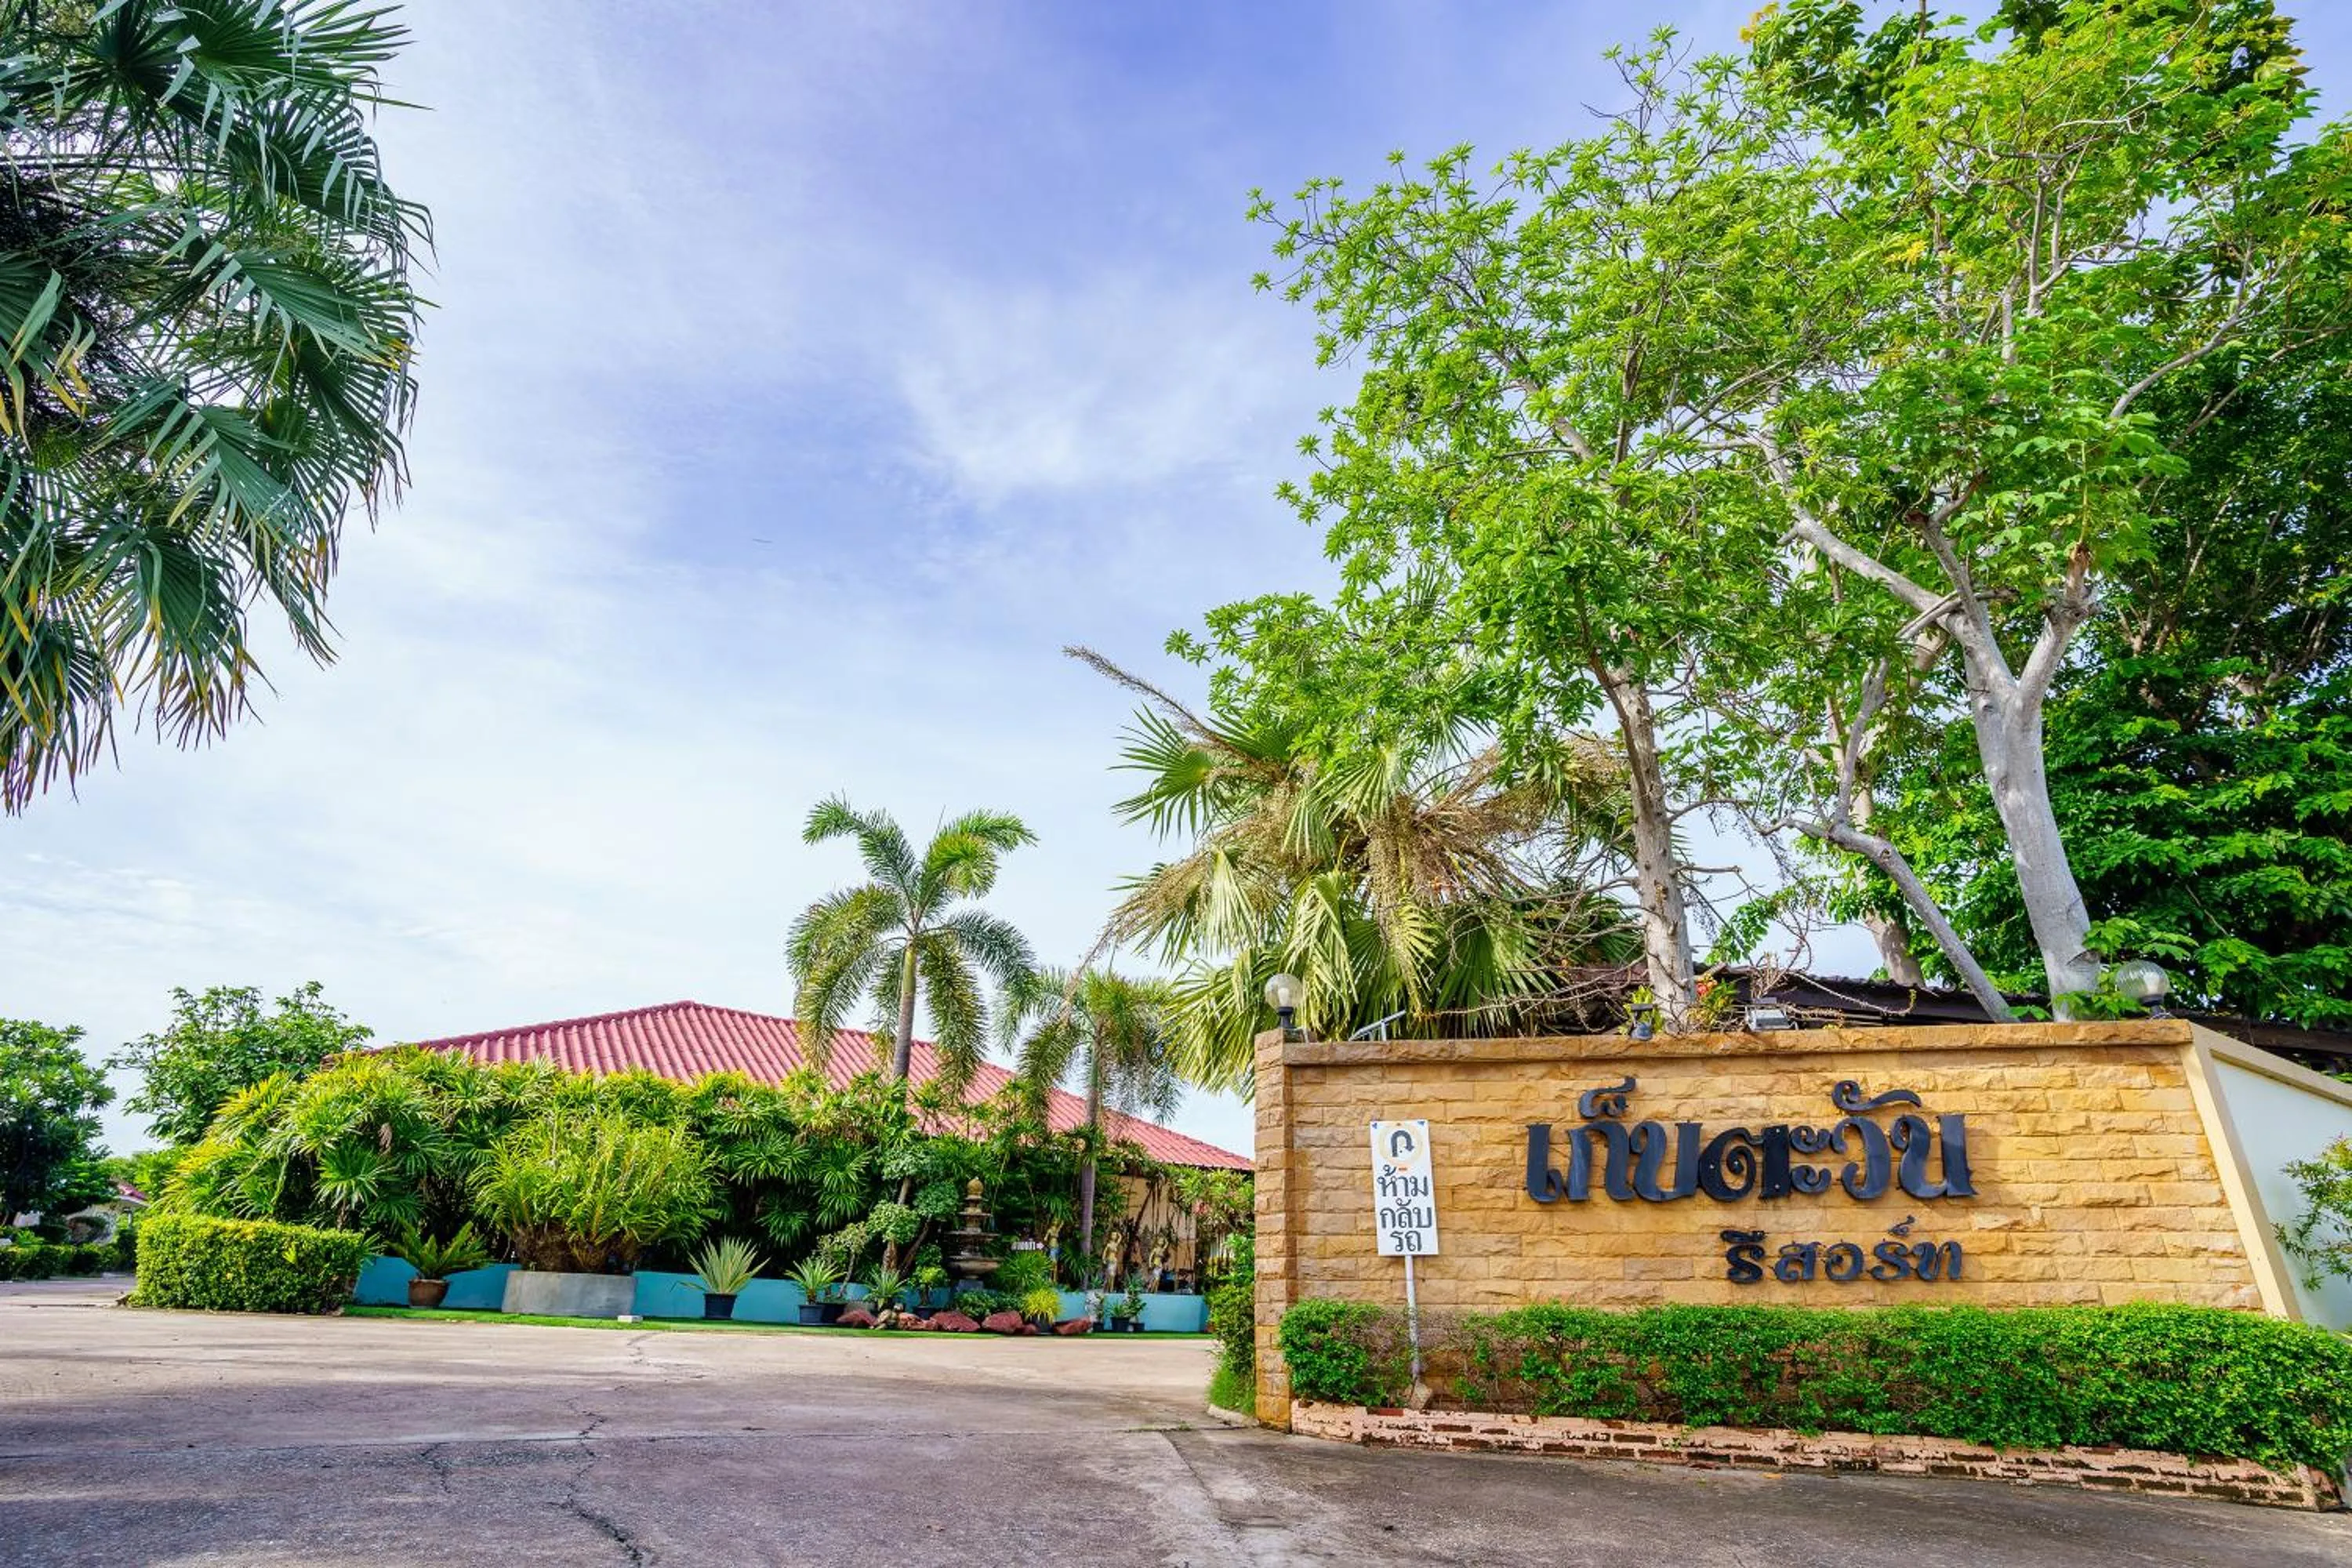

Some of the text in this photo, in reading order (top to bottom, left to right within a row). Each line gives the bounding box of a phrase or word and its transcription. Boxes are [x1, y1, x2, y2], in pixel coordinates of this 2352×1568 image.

[1526, 1076, 1979, 1203] เก็บตะวัน
[1377, 1164, 1429, 1197] ห้าม
[1379, 1198, 1432, 1229] กลับ
[1390, 1230, 1423, 1252] รถ
[1720, 1215, 1963, 1284] รีสอร์ท
